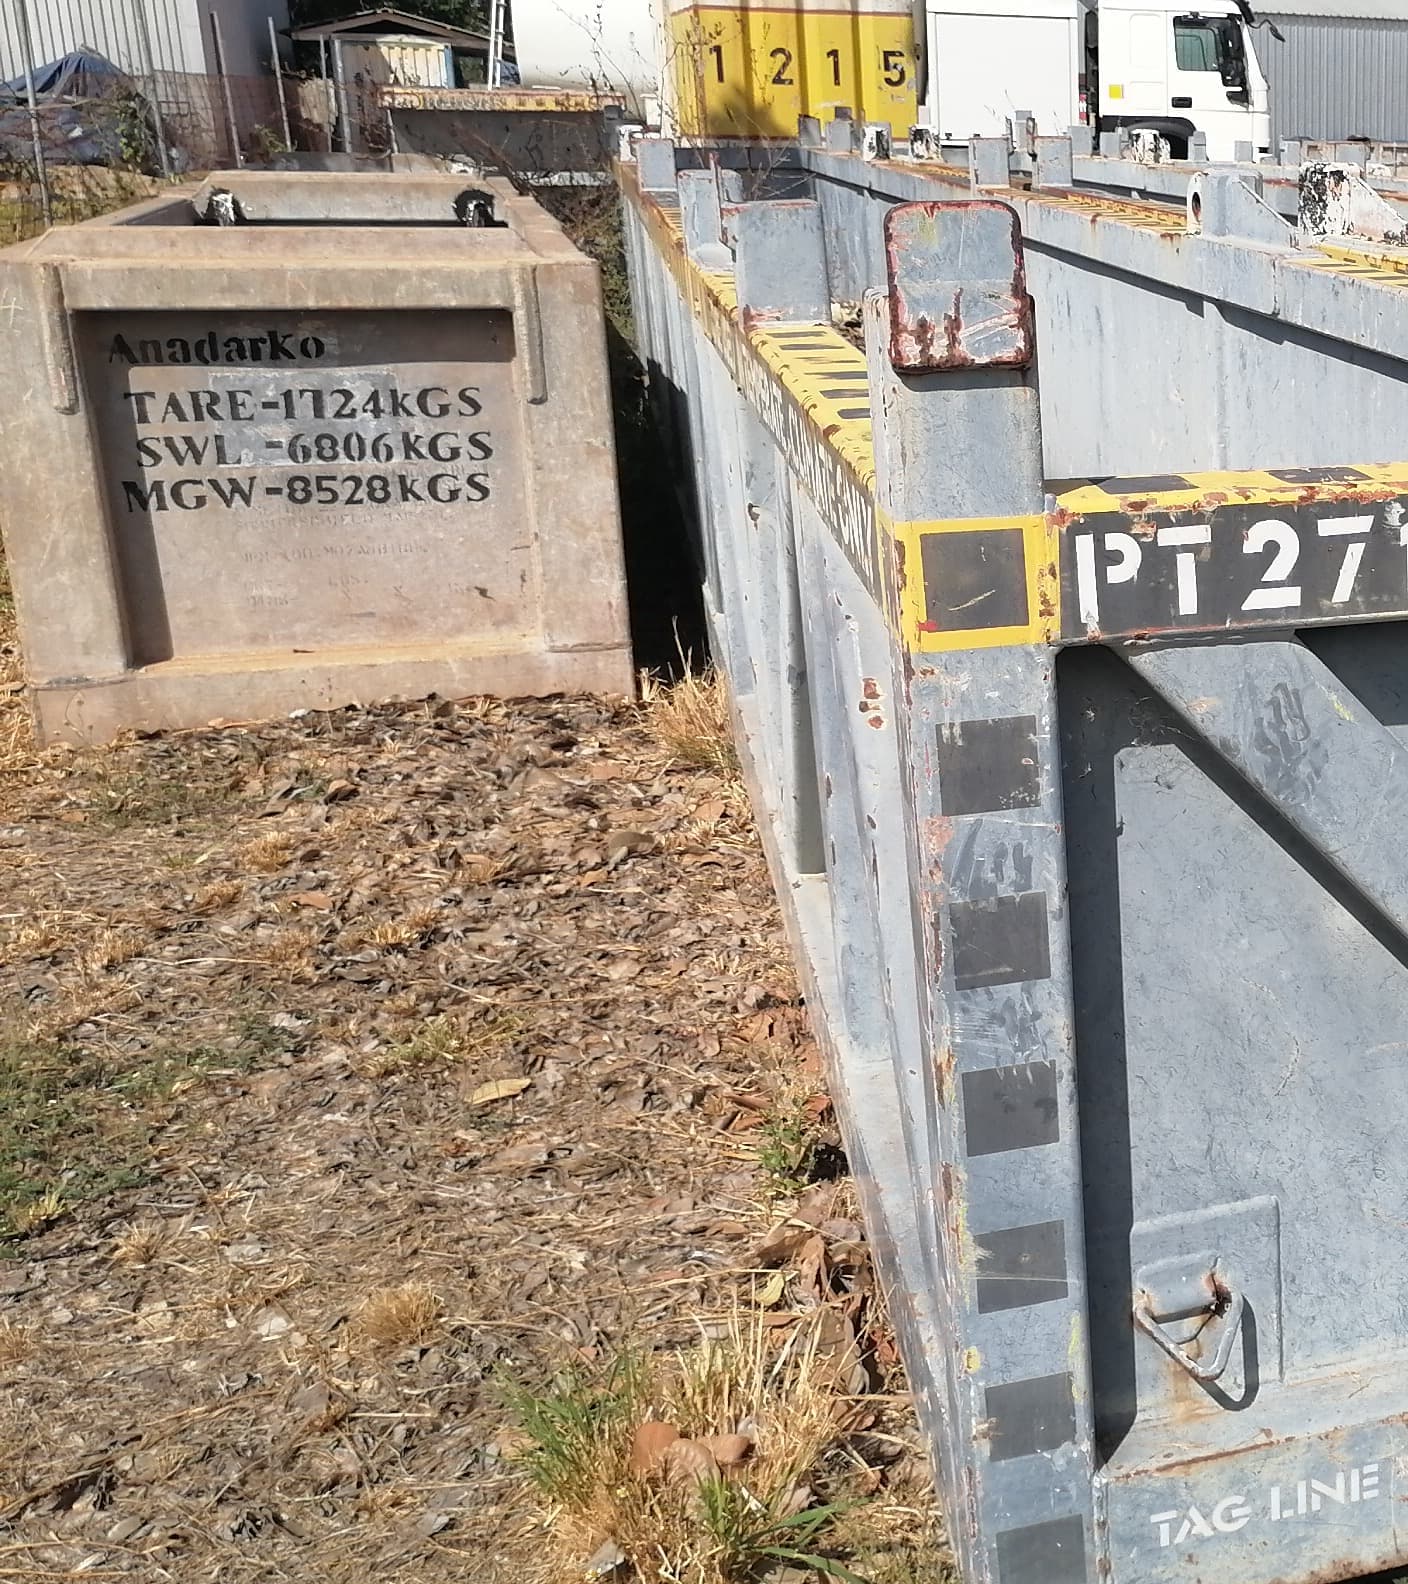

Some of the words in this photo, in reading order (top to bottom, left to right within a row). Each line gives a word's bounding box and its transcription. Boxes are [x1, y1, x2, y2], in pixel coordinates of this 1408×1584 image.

[1075, 523, 1212, 624] PT
[1150, 1494, 1253, 1548] TAG
[1271, 1463, 1380, 1522] LINE
